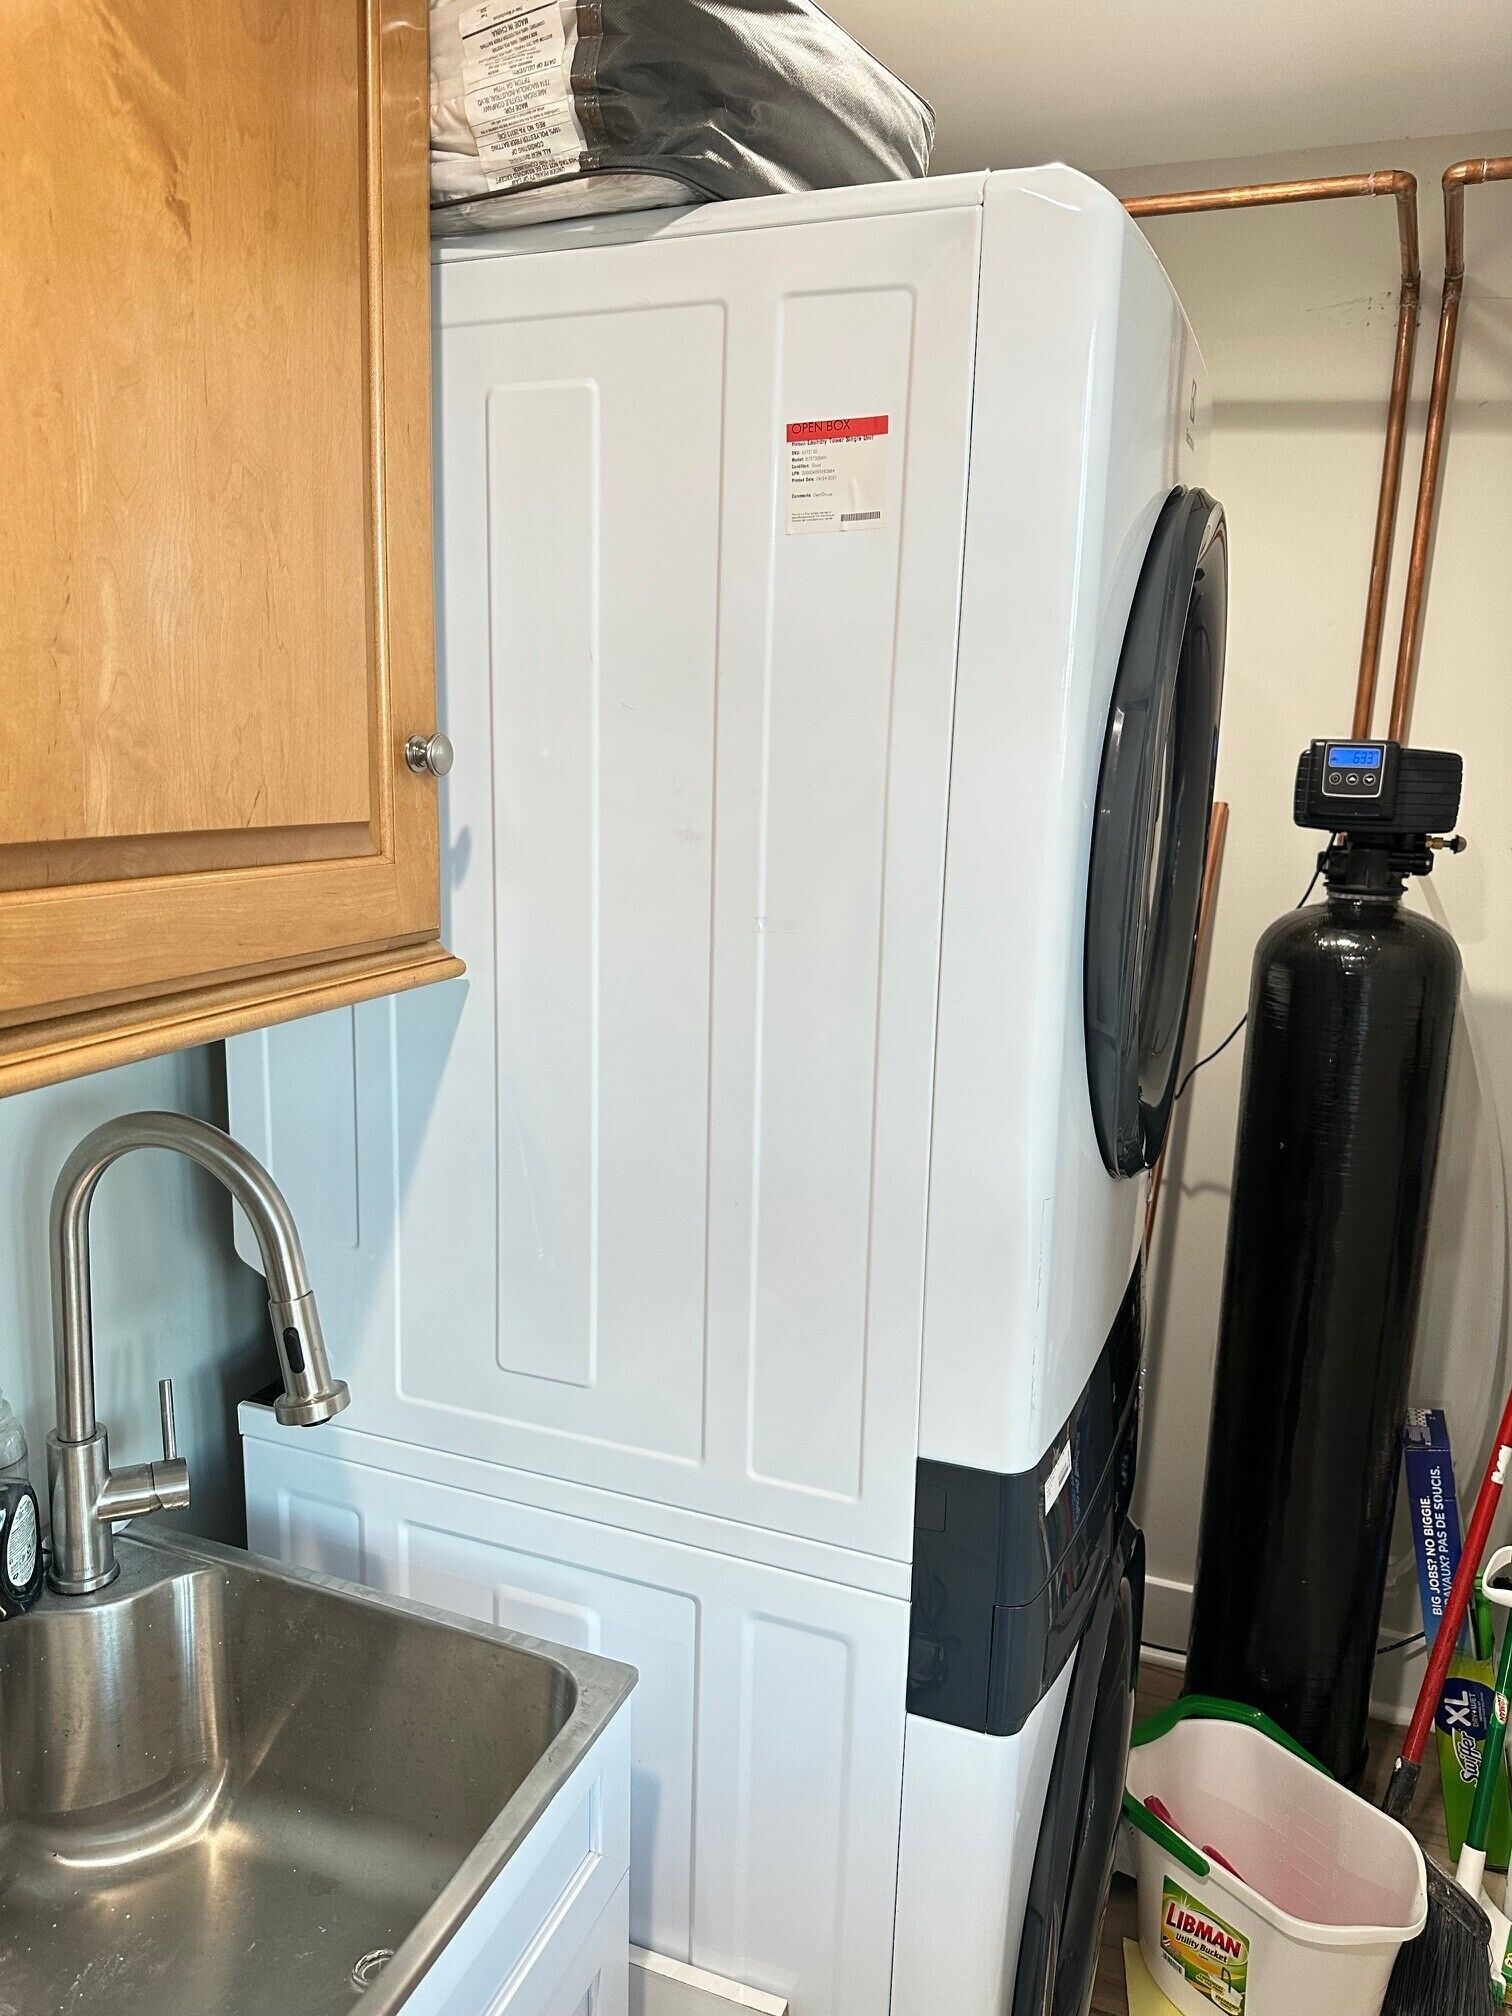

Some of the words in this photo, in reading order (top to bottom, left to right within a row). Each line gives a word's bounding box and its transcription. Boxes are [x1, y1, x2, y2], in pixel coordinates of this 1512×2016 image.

[514, 17, 529, 28] MADE
[491, 26, 507, 37] CHINA
[505, 96, 523, 106] TEXTILE
[523, 89, 547, 100] AMERICAN
[483, 101, 505, 112] COMPANY
[516, 102, 529, 111] MADE
[510, 137, 523, 146] FIBER
[523, 131, 549, 143] POLYESTER
[491, 140, 510, 152] BATTING
[792, 422, 823, 435] OPEN
[827, 419, 850, 431] BOX
[1353, 751, 1374, 765] 633
[1430, 1465, 1445, 1510] SOUCIS.
[1420, 1495, 1434, 1537] BIGGIE.
[1435, 1512, 1446, 1529] DE
[1425, 1538, 1436, 1556] NO
[1437, 1531, 1449, 1553] PAS
[1427, 1556, 1440, 1595] JOBS?
[1440, 1554, 1452, 1606] AVAUX?
[1432, 1595, 1443, 1616] BIG
[1444, 1690, 1472, 1727] XL
[1457, 1729, 1482, 1787] Swiffer
[1165, 1901, 1242, 1959] LIBMAN
[1175, 1933, 1199, 1950] Utility
[1200, 1944, 1228, 1963] Bucket
